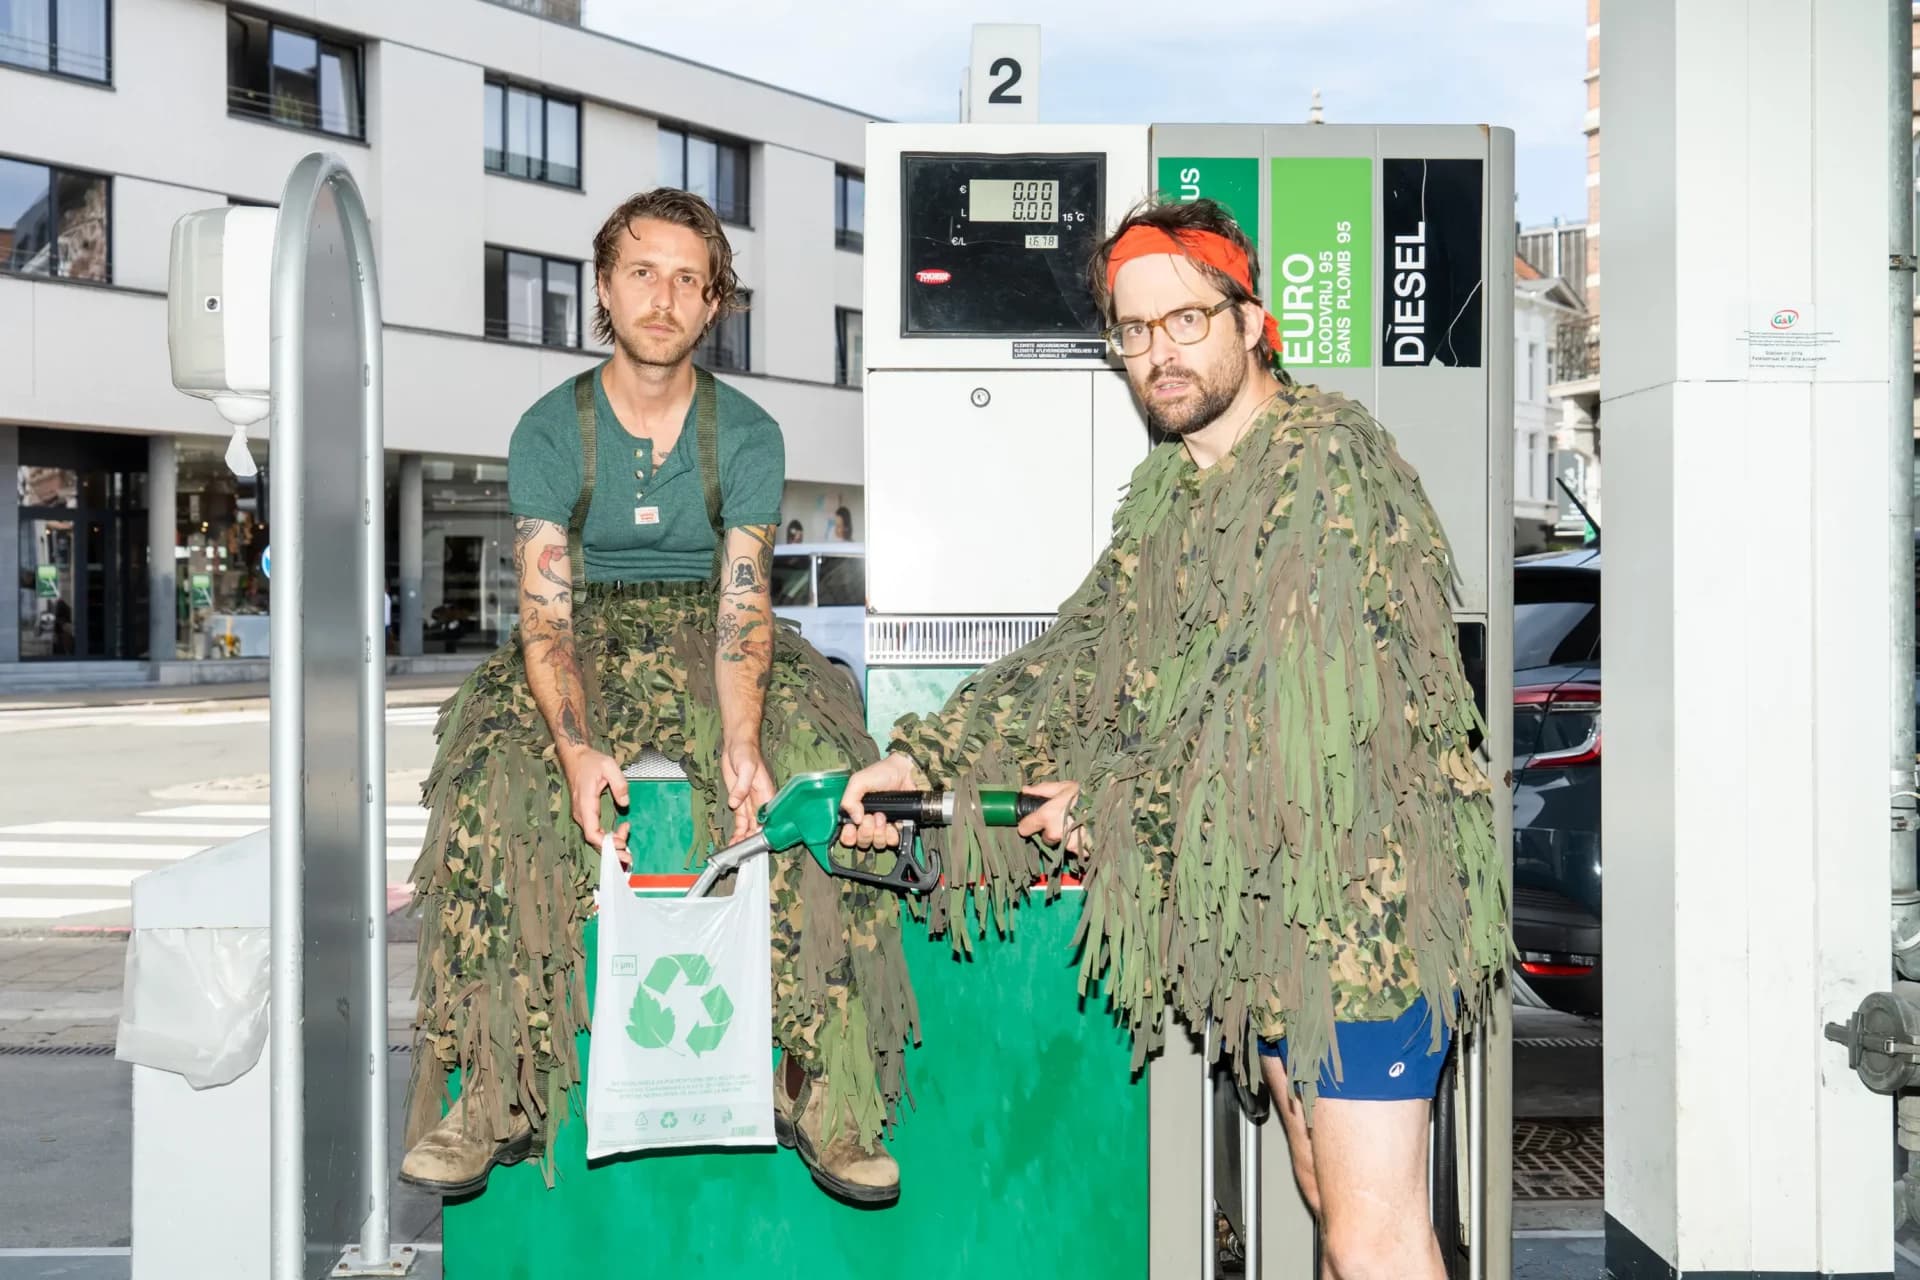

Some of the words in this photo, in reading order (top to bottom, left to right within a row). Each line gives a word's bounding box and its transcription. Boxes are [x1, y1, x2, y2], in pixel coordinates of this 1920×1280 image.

[988, 57, 1022, 104] 2
[1180, 167, 1200, 201] US
[961, 208, 967, 217] L
[1062, 213, 1073, 222] 15
[1336, 220, 1352, 244] 95
[1319, 251, 1334, 273] 95
[1336, 250, 1352, 309] PLOMB
[1283, 253, 1315, 364] EURO
[1394, 221, 1427, 363] DIESEL
[1318, 280, 1333, 364] LOODVRIJ
[1336, 318, 1352, 364] SANS
